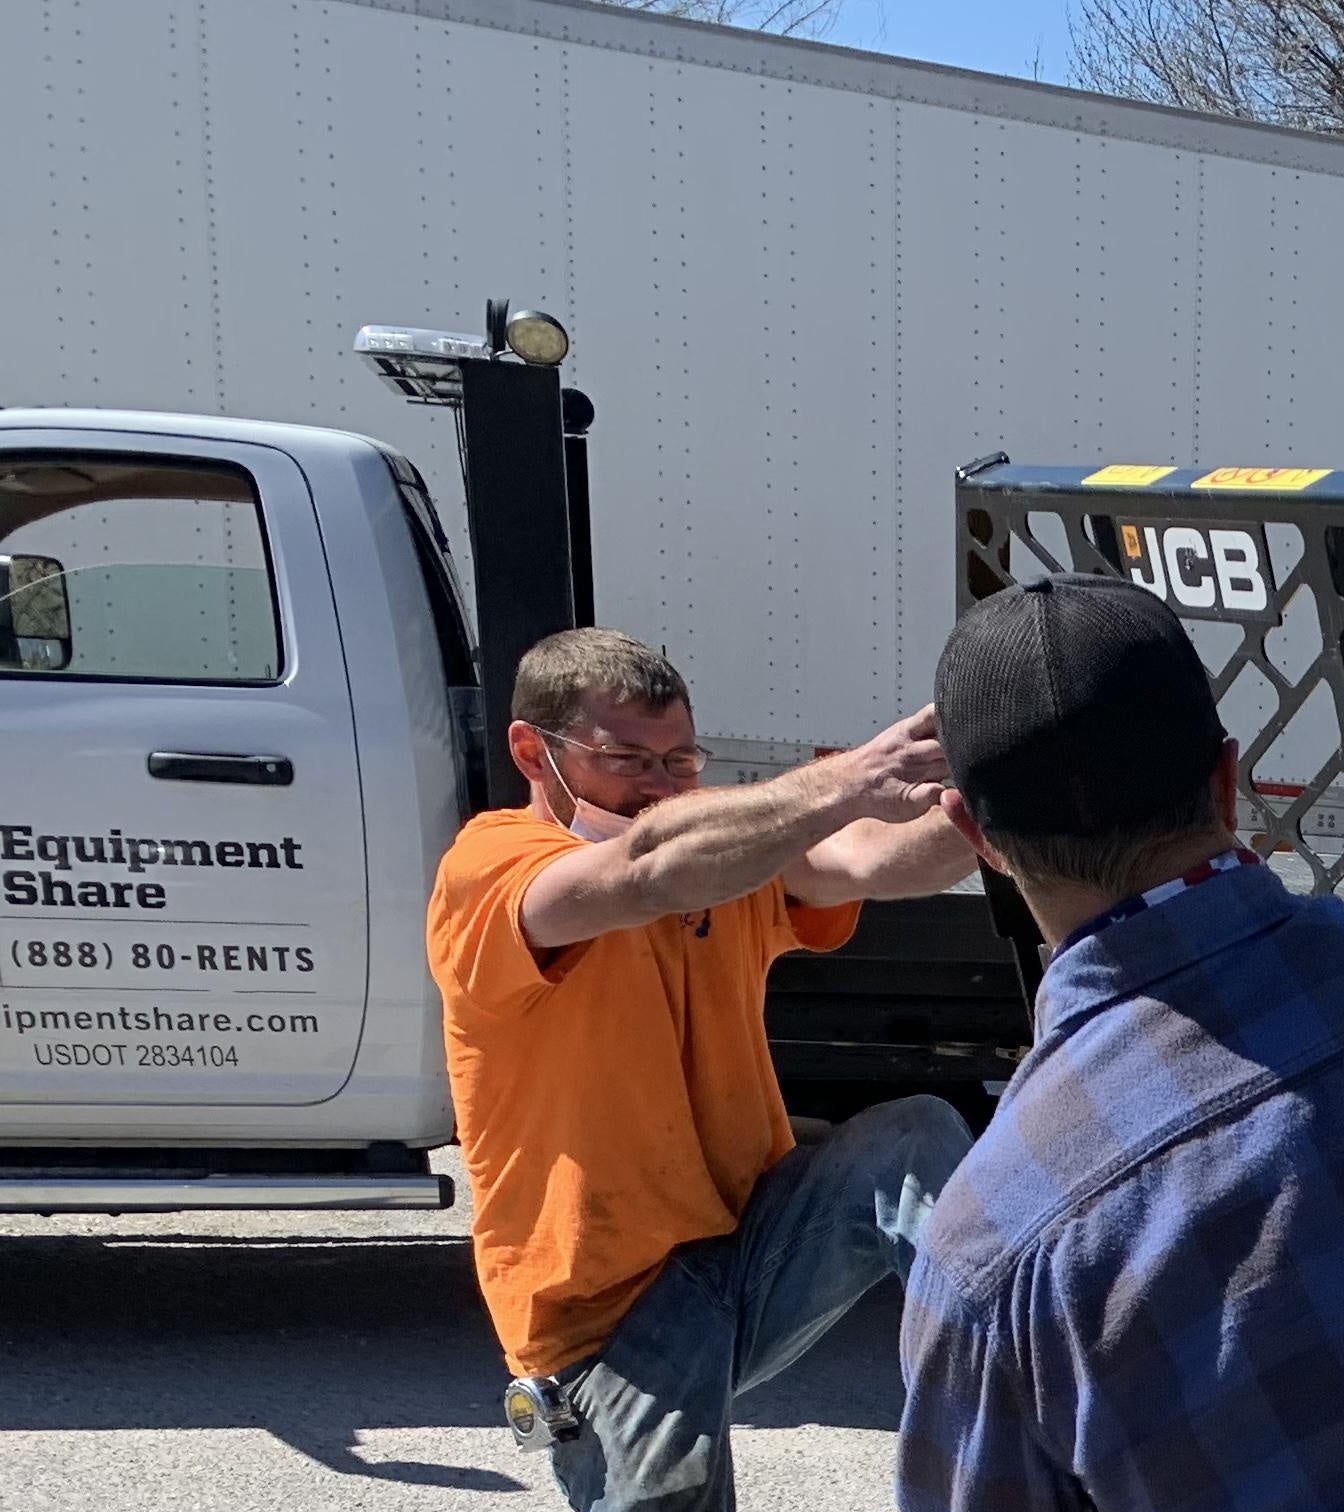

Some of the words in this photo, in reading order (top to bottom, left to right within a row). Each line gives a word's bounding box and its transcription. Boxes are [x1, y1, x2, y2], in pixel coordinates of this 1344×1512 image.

[1130, 527, 1268, 611] JCB
[0, 825, 304, 873] Equipment
[2, 870, 167, 909] Share
[11, 939, 113, 970] (888)
[131, 943, 316, 972] 80-RENTS
[3, 1004, 319, 1034] ipmentshare.com
[34, 1044, 127, 1066] USDOT
[136, 1045, 239, 1067] 2834104
